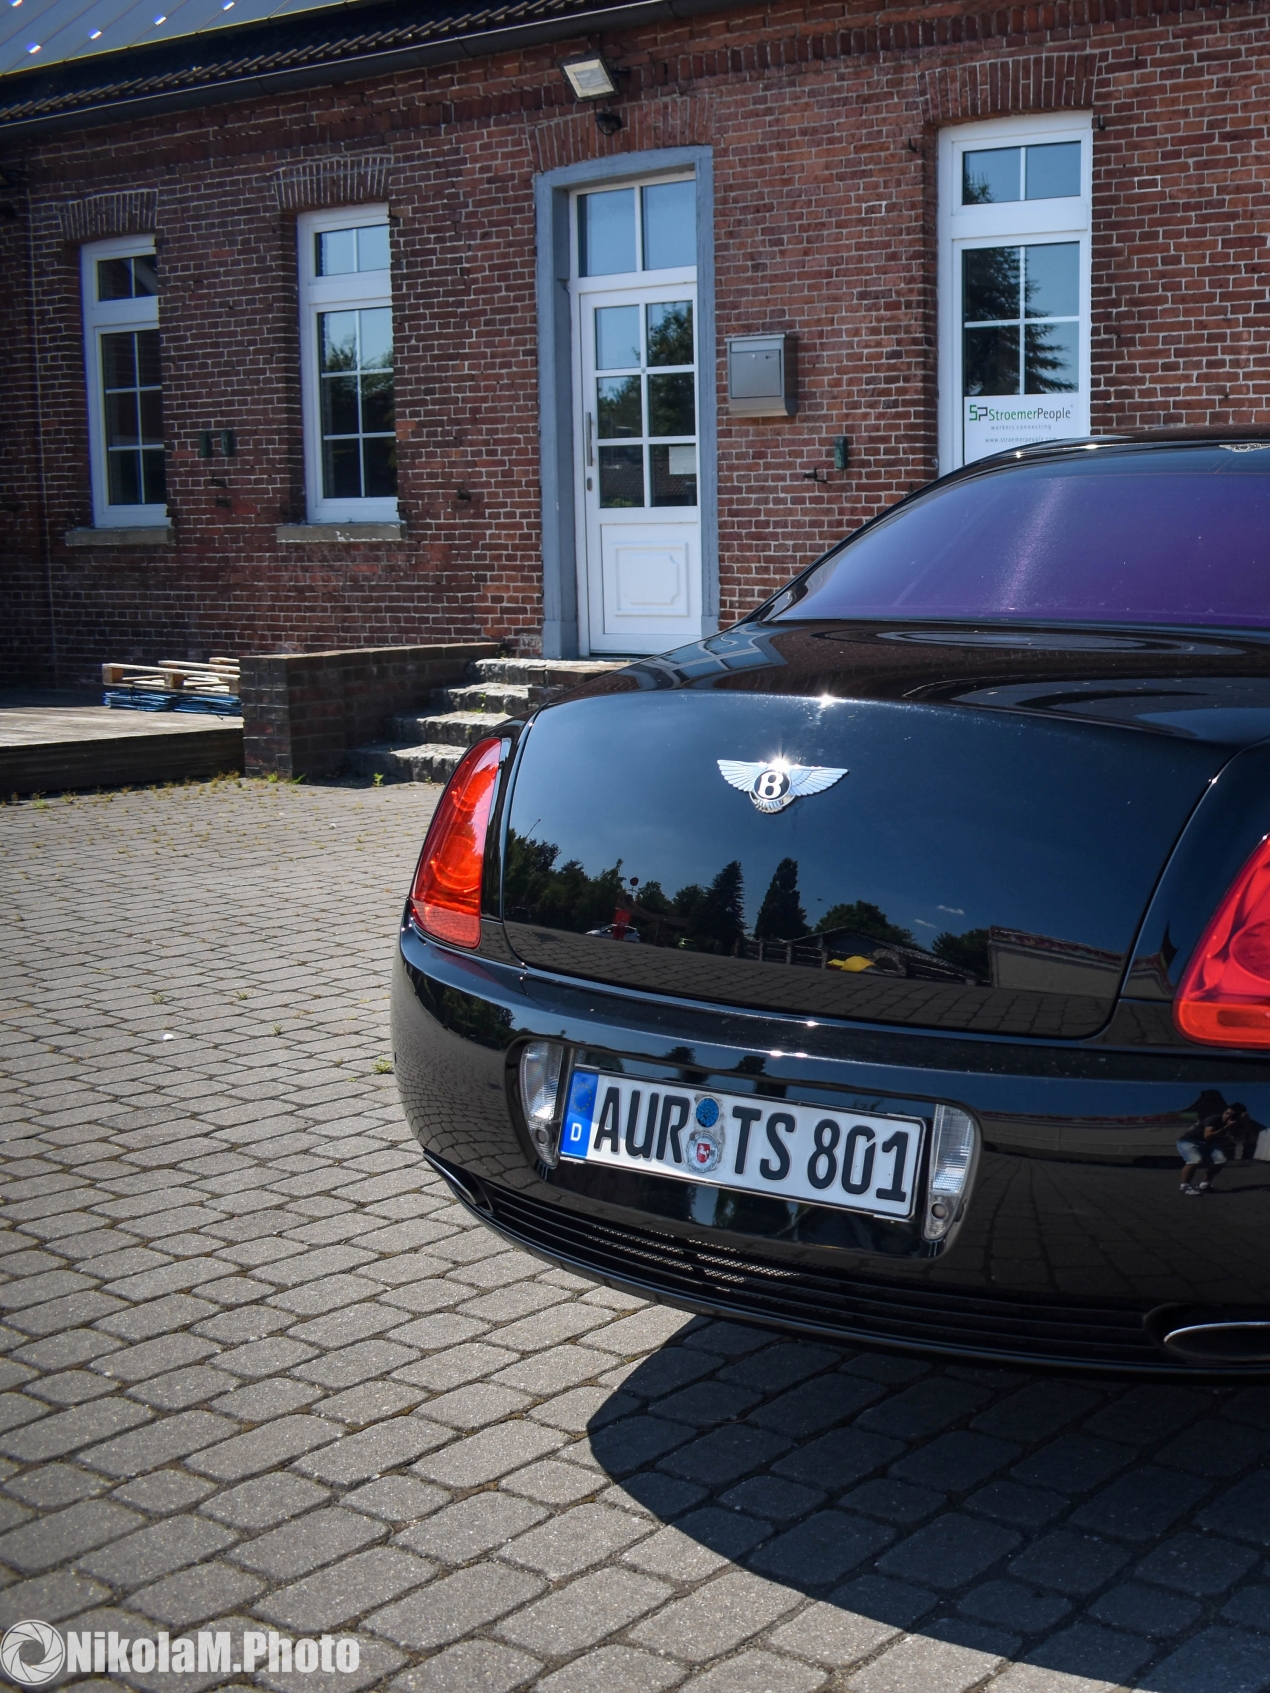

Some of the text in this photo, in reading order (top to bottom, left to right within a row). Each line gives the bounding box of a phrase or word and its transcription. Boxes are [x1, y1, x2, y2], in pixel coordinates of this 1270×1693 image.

[988, 407, 1071, 422] StroemerPeople
[593, 1085, 693, 1164] AUR
[731, 1104, 797, 1181] TS
[806, 1118, 910, 1203] 801
